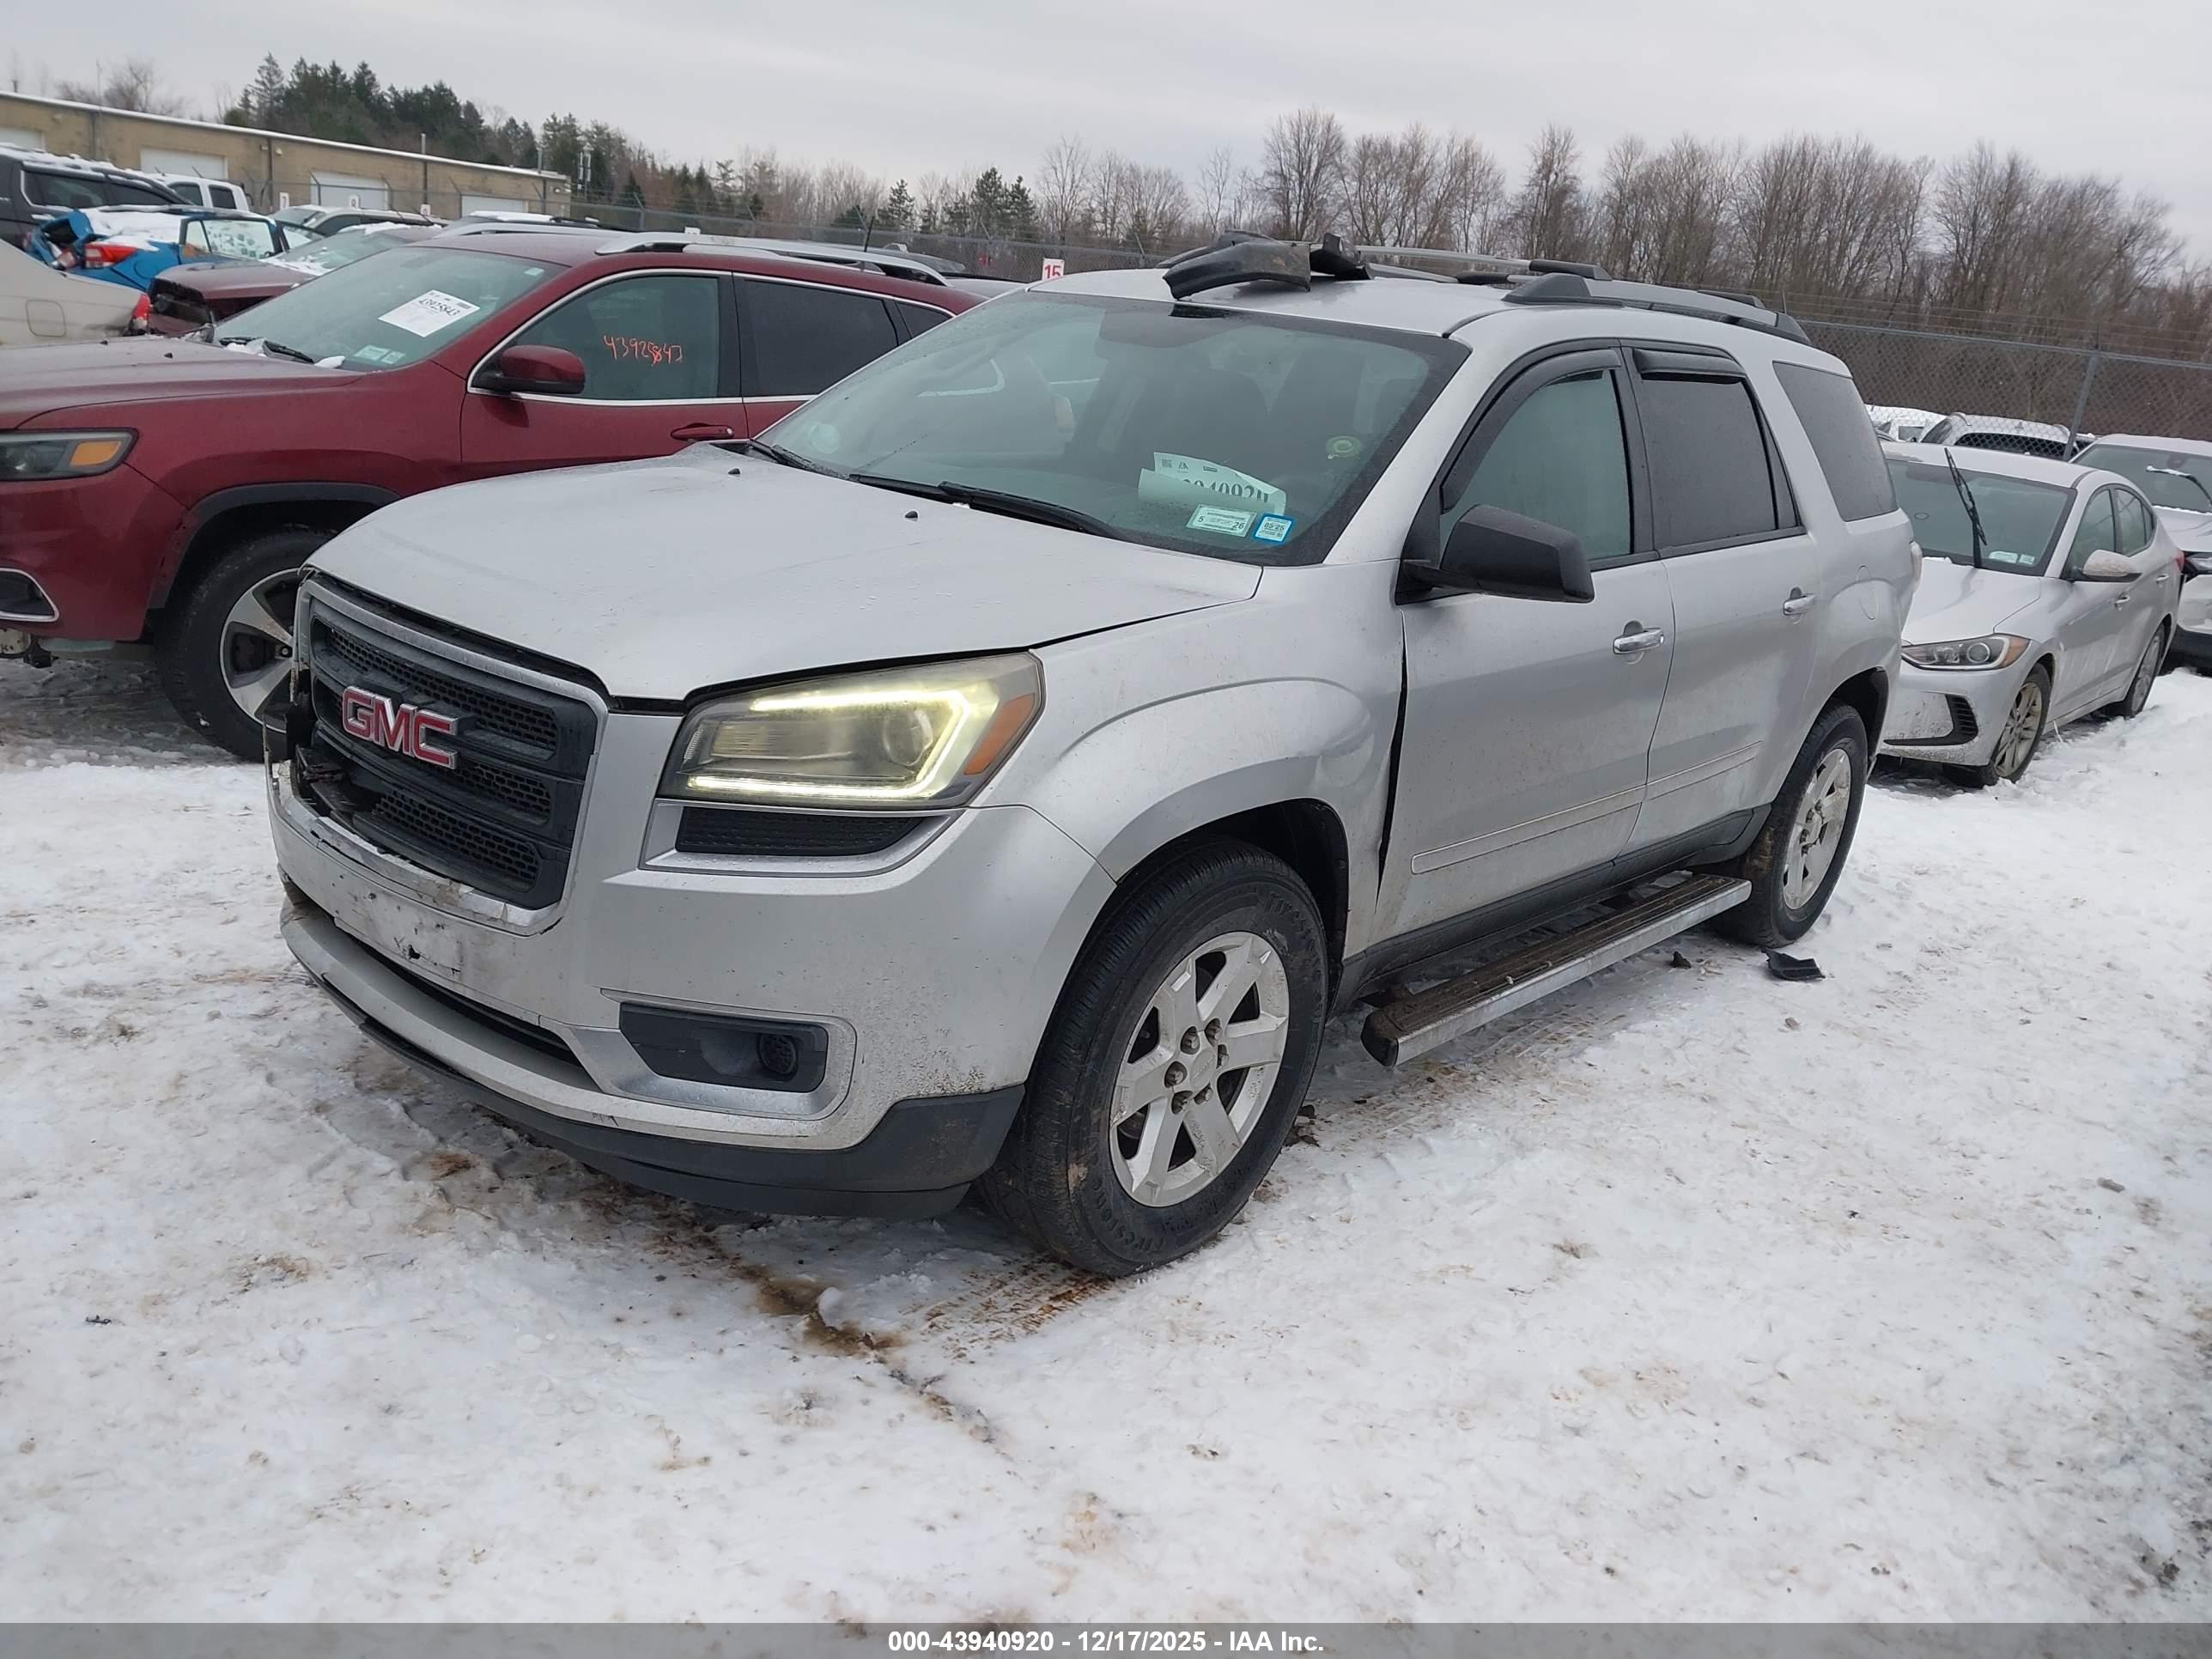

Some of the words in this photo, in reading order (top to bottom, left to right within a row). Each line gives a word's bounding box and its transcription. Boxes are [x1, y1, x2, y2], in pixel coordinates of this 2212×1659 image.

[1044, 264, 1061, 279] 15
[1231, 521, 1246, 530] 26
[343, 686, 459, 770] GMC
